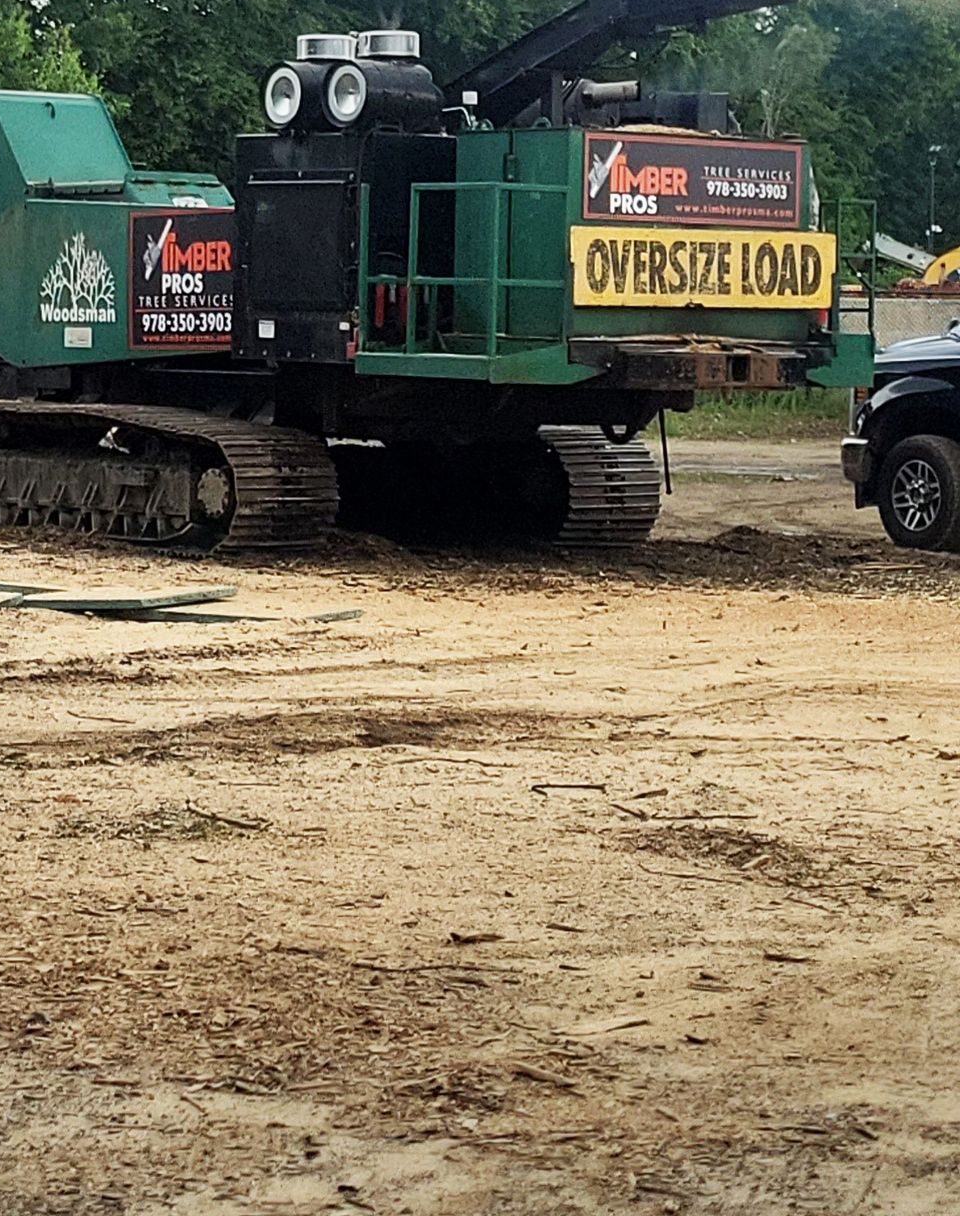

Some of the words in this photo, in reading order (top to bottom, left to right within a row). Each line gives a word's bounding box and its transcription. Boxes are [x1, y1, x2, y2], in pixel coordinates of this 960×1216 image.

[610, 153, 689, 196] TIMBER
[704, 166, 730, 179] TREE
[737, 168, 792, 182] SERVICES
[609, 193, 657, 214] PROS
[161, 232, 232, 273] TIMBER
[586, 238, 732, 296] OVERSIZE
[741, 241, 823, 297] LOAD
[161, 272, 204, 295] PROS
[139, 295, 167, 309] TREE
[40, 303, 117, 324] Woodsman
